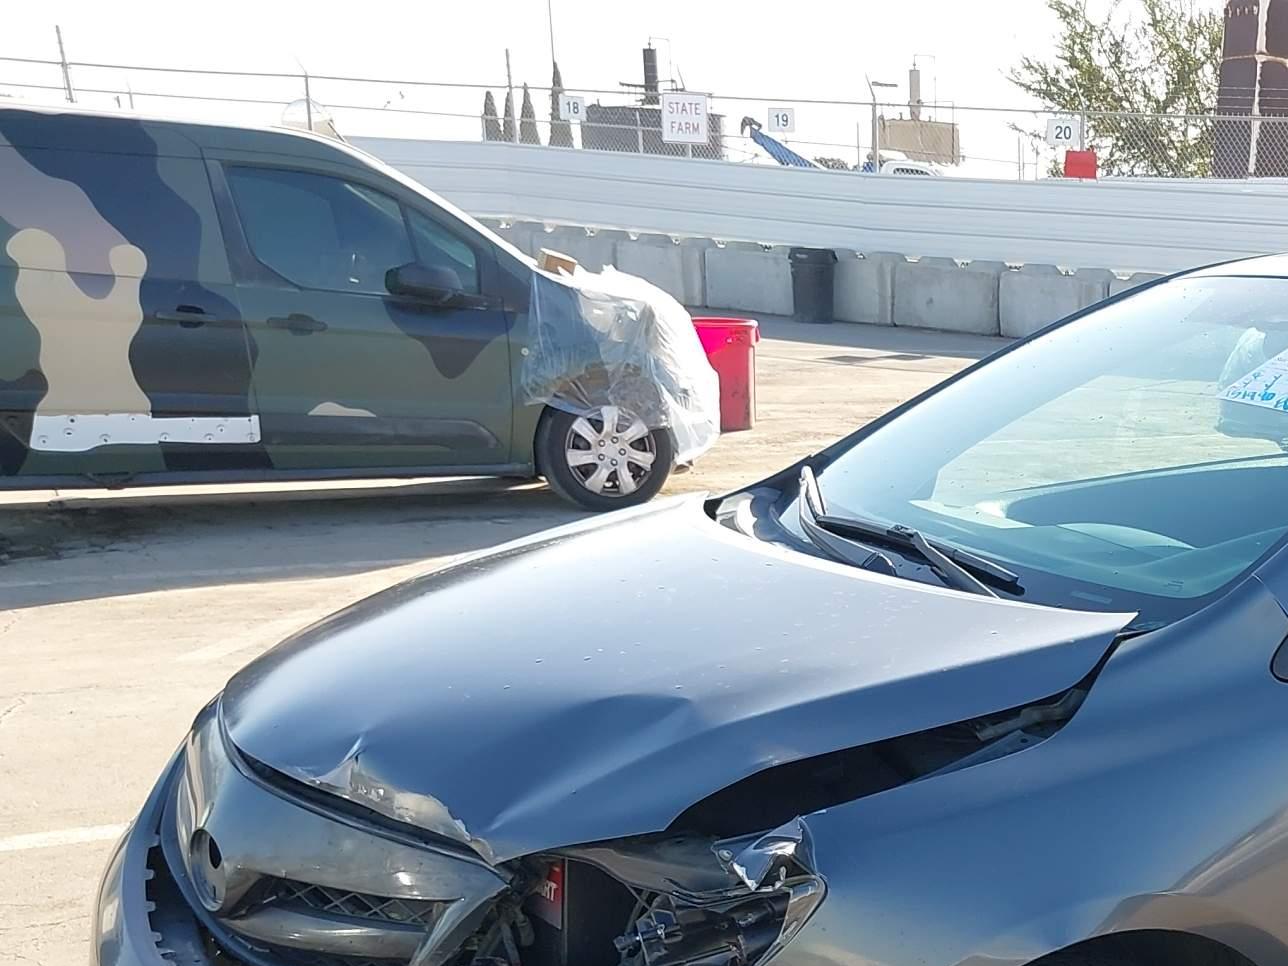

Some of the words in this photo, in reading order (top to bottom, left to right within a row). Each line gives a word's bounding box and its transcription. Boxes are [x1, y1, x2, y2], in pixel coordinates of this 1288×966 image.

[565, 101, 580, 115] 18
[668, 101, 701, 117] STATE
[670, 120, 700, 136] FARM
[774, 113, 789, 128] 19
[1054, 123, 1073, 140] 20
